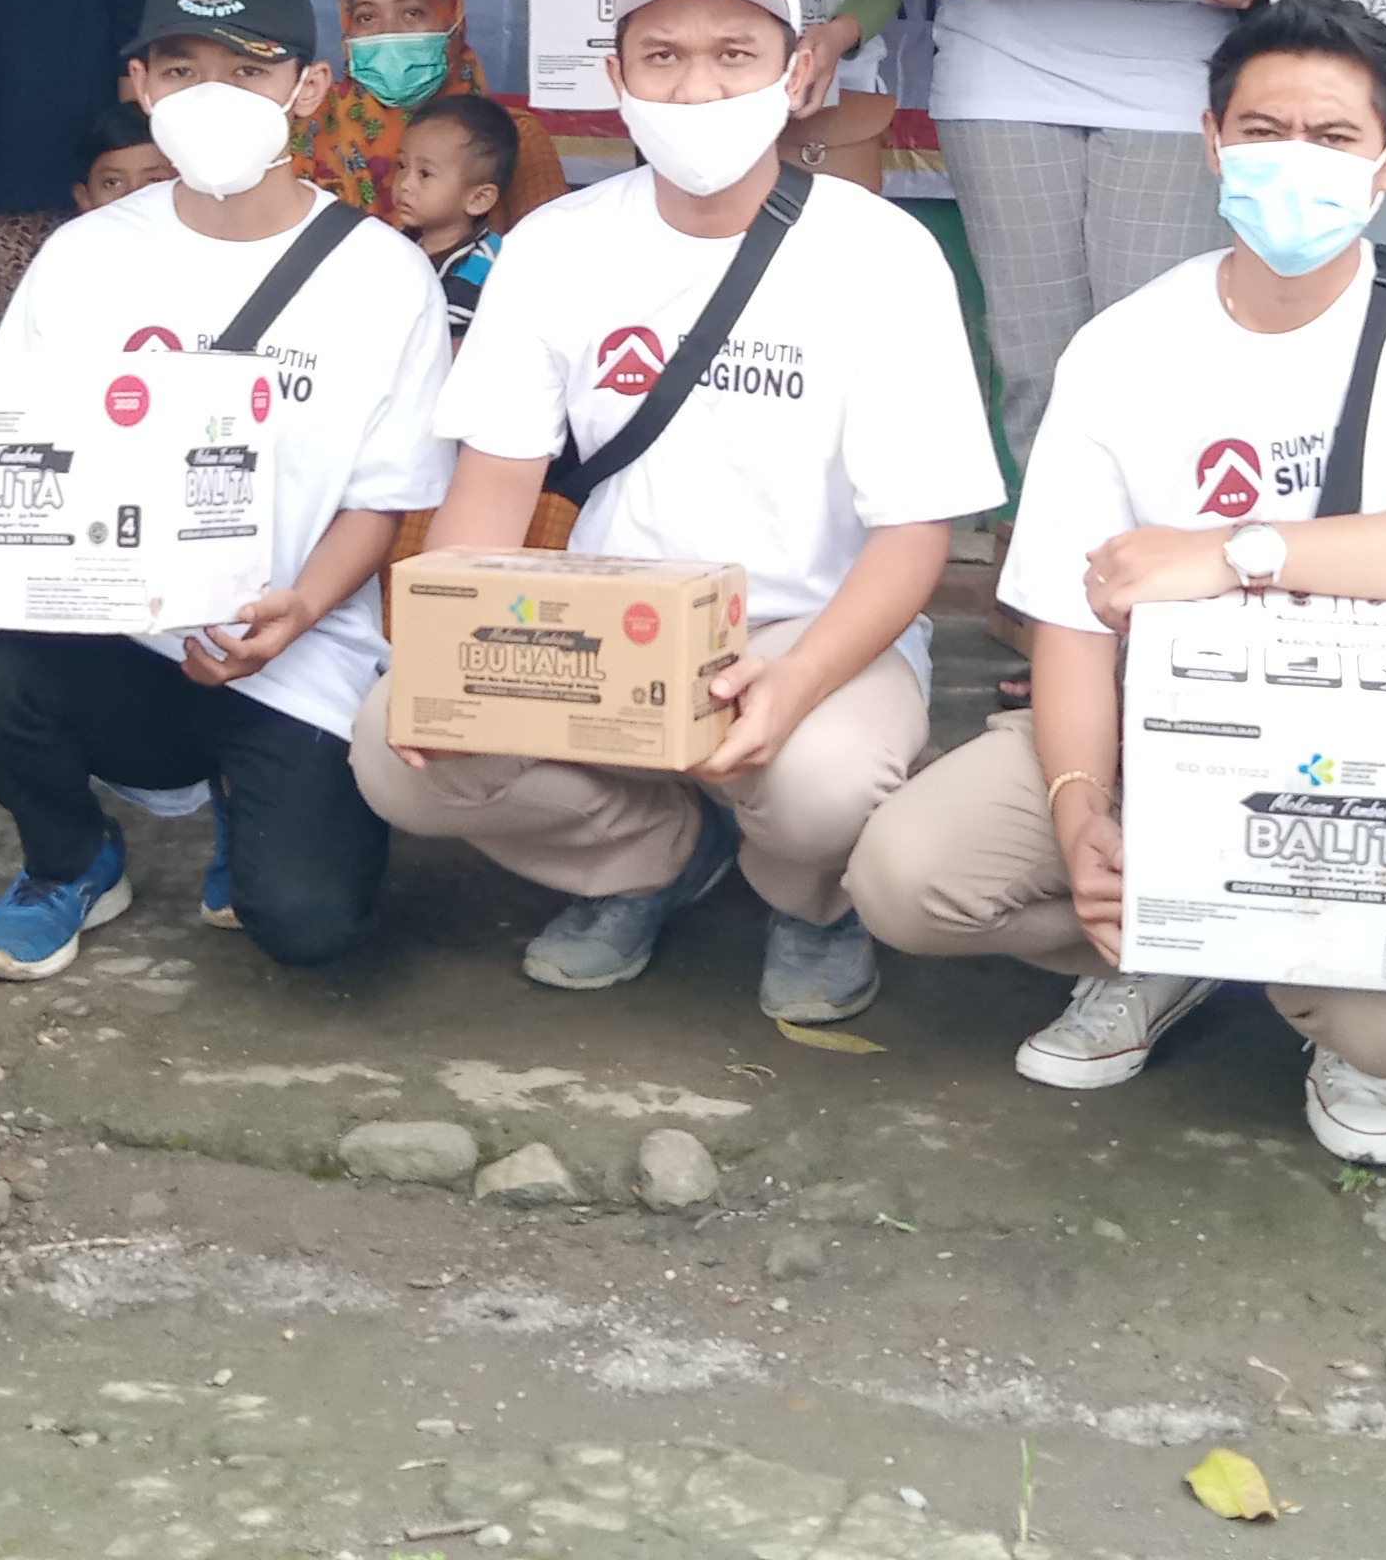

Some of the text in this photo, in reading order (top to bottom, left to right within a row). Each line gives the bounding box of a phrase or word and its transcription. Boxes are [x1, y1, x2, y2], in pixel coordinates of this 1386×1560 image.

[752, 341, 803, 365] PUTIH
[185, 468, 253, 507] BALITA
[121, 517, 135, 536] 4
[459, 642, 606, 680] IBU HAMIL
[1176, 762, 1199, 773] ED
